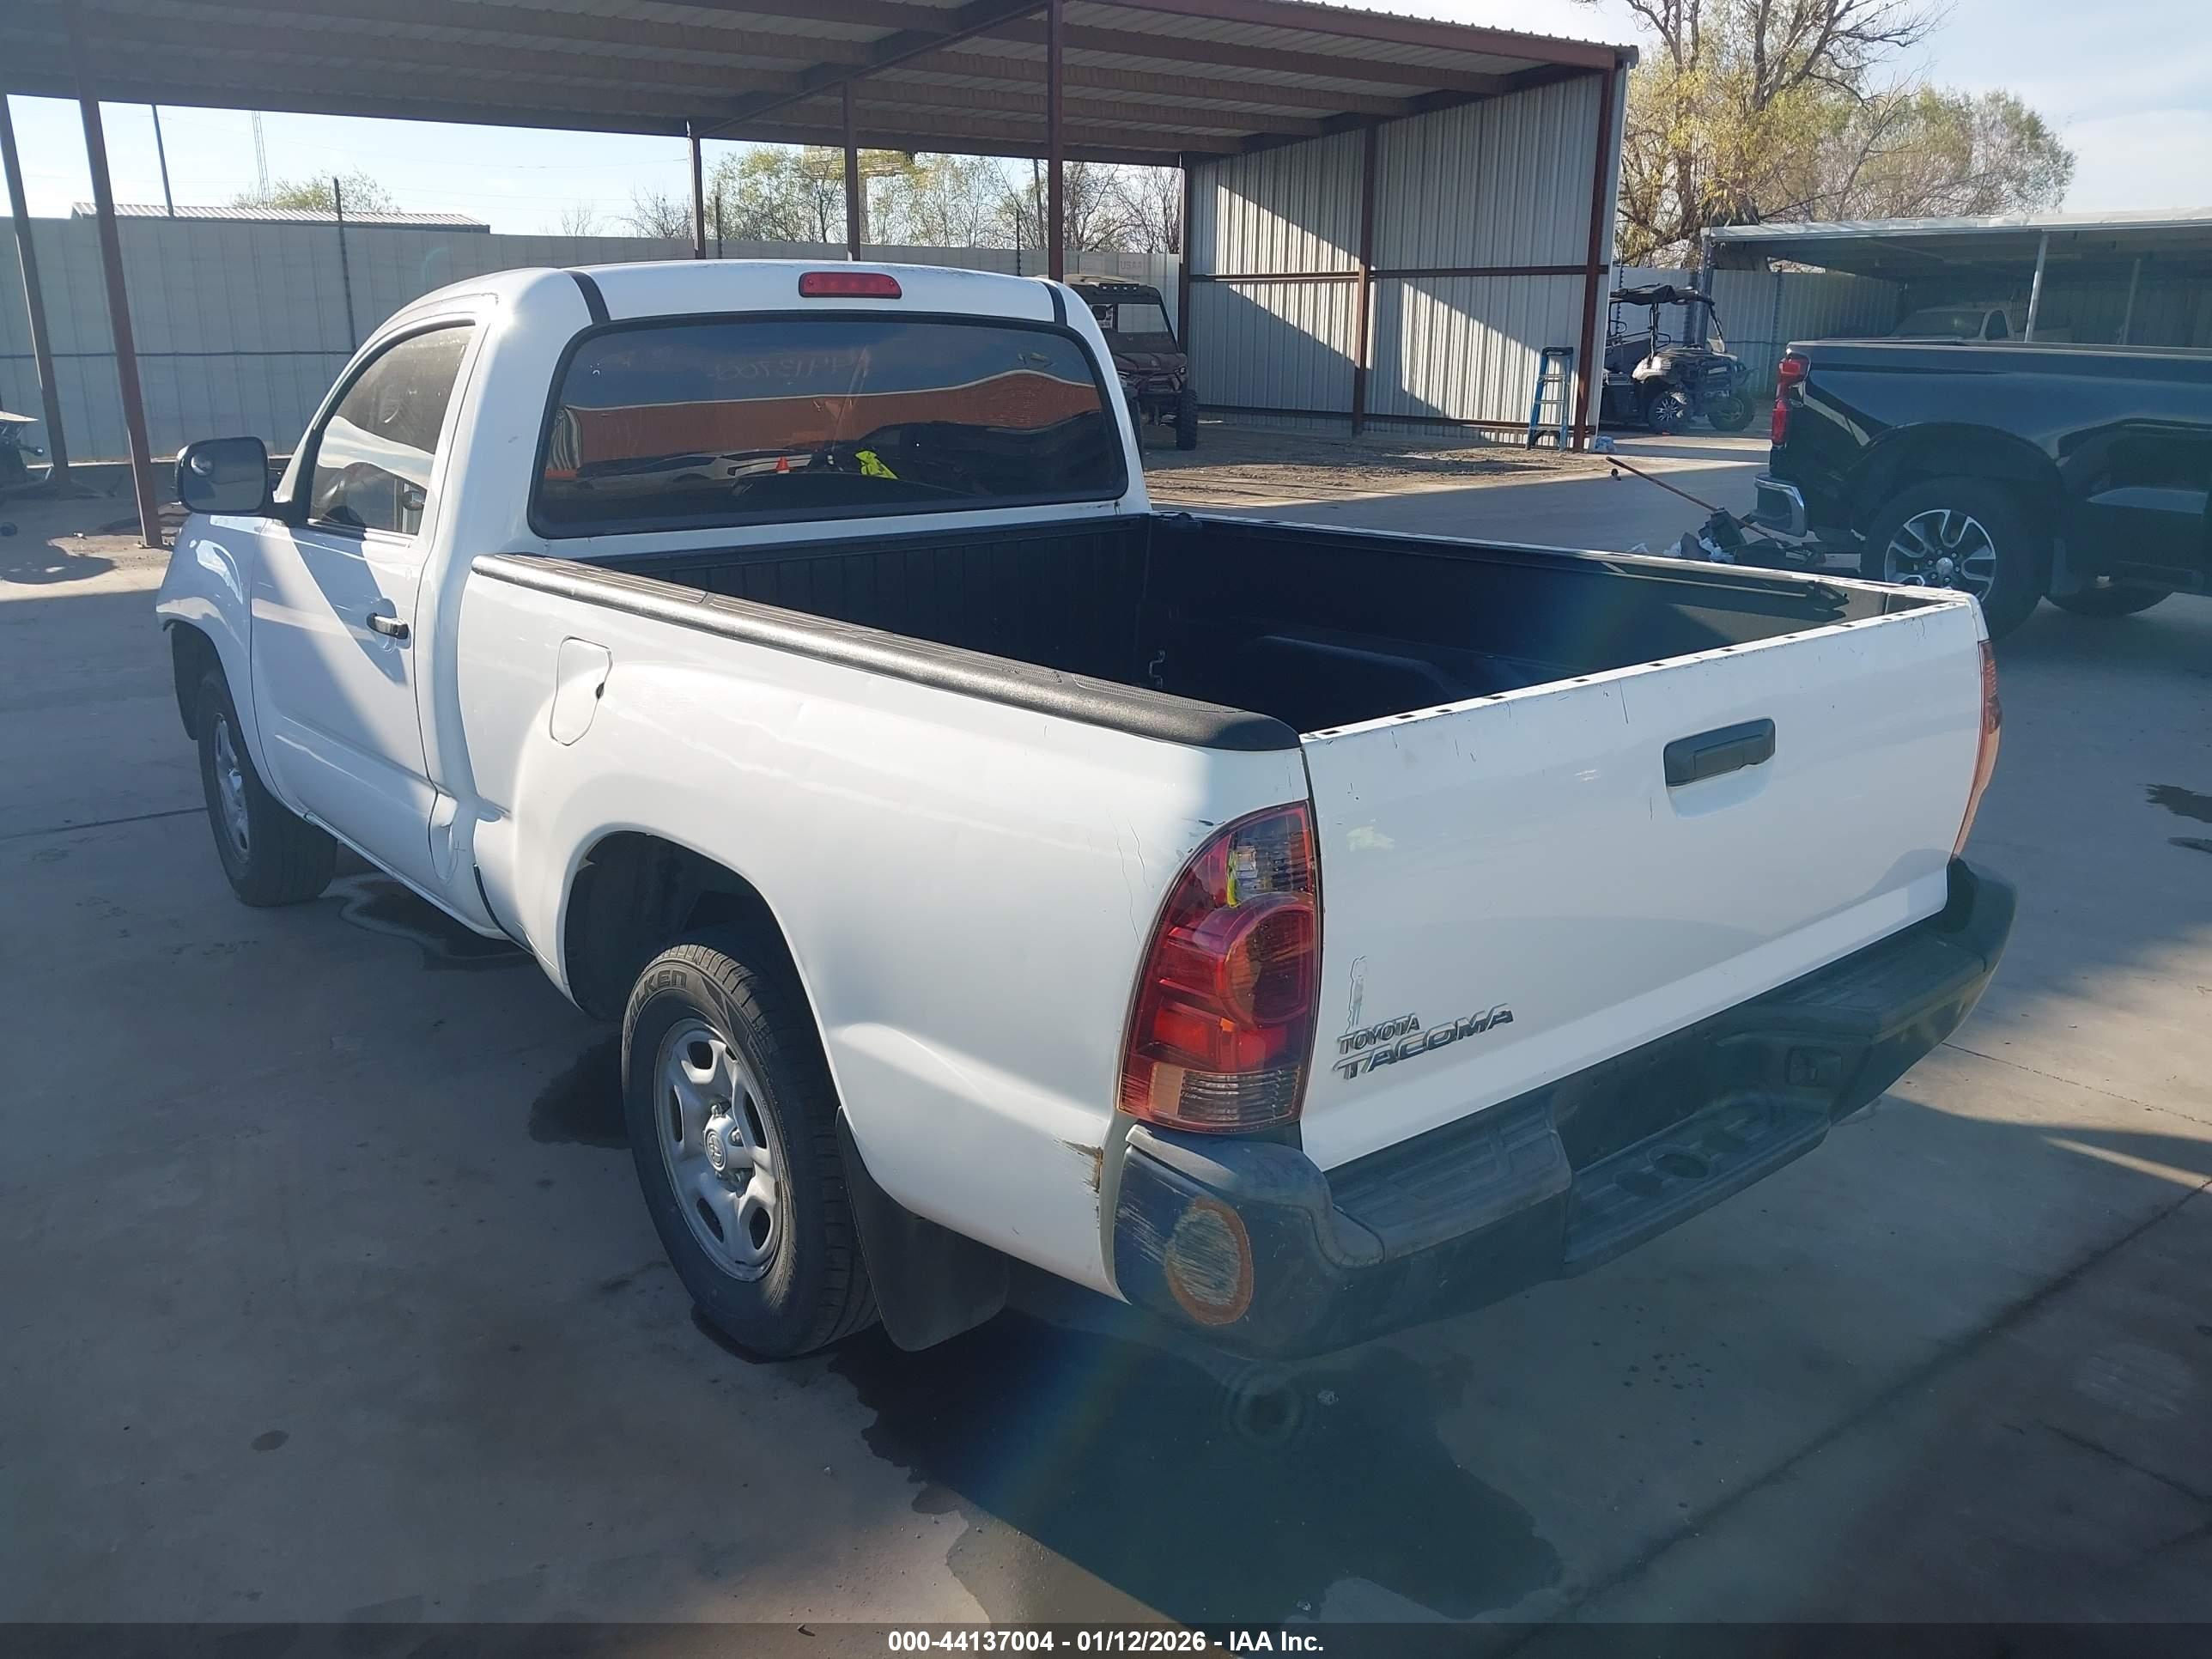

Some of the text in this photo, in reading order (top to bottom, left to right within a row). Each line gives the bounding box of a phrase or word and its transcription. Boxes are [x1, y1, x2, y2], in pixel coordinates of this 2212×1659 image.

[1120, 260, 1142, 270] USAA
[1332, 1003, 1514, 1080] TACOMA
[1337, 1013, 1420, 1054] TOYOTA
